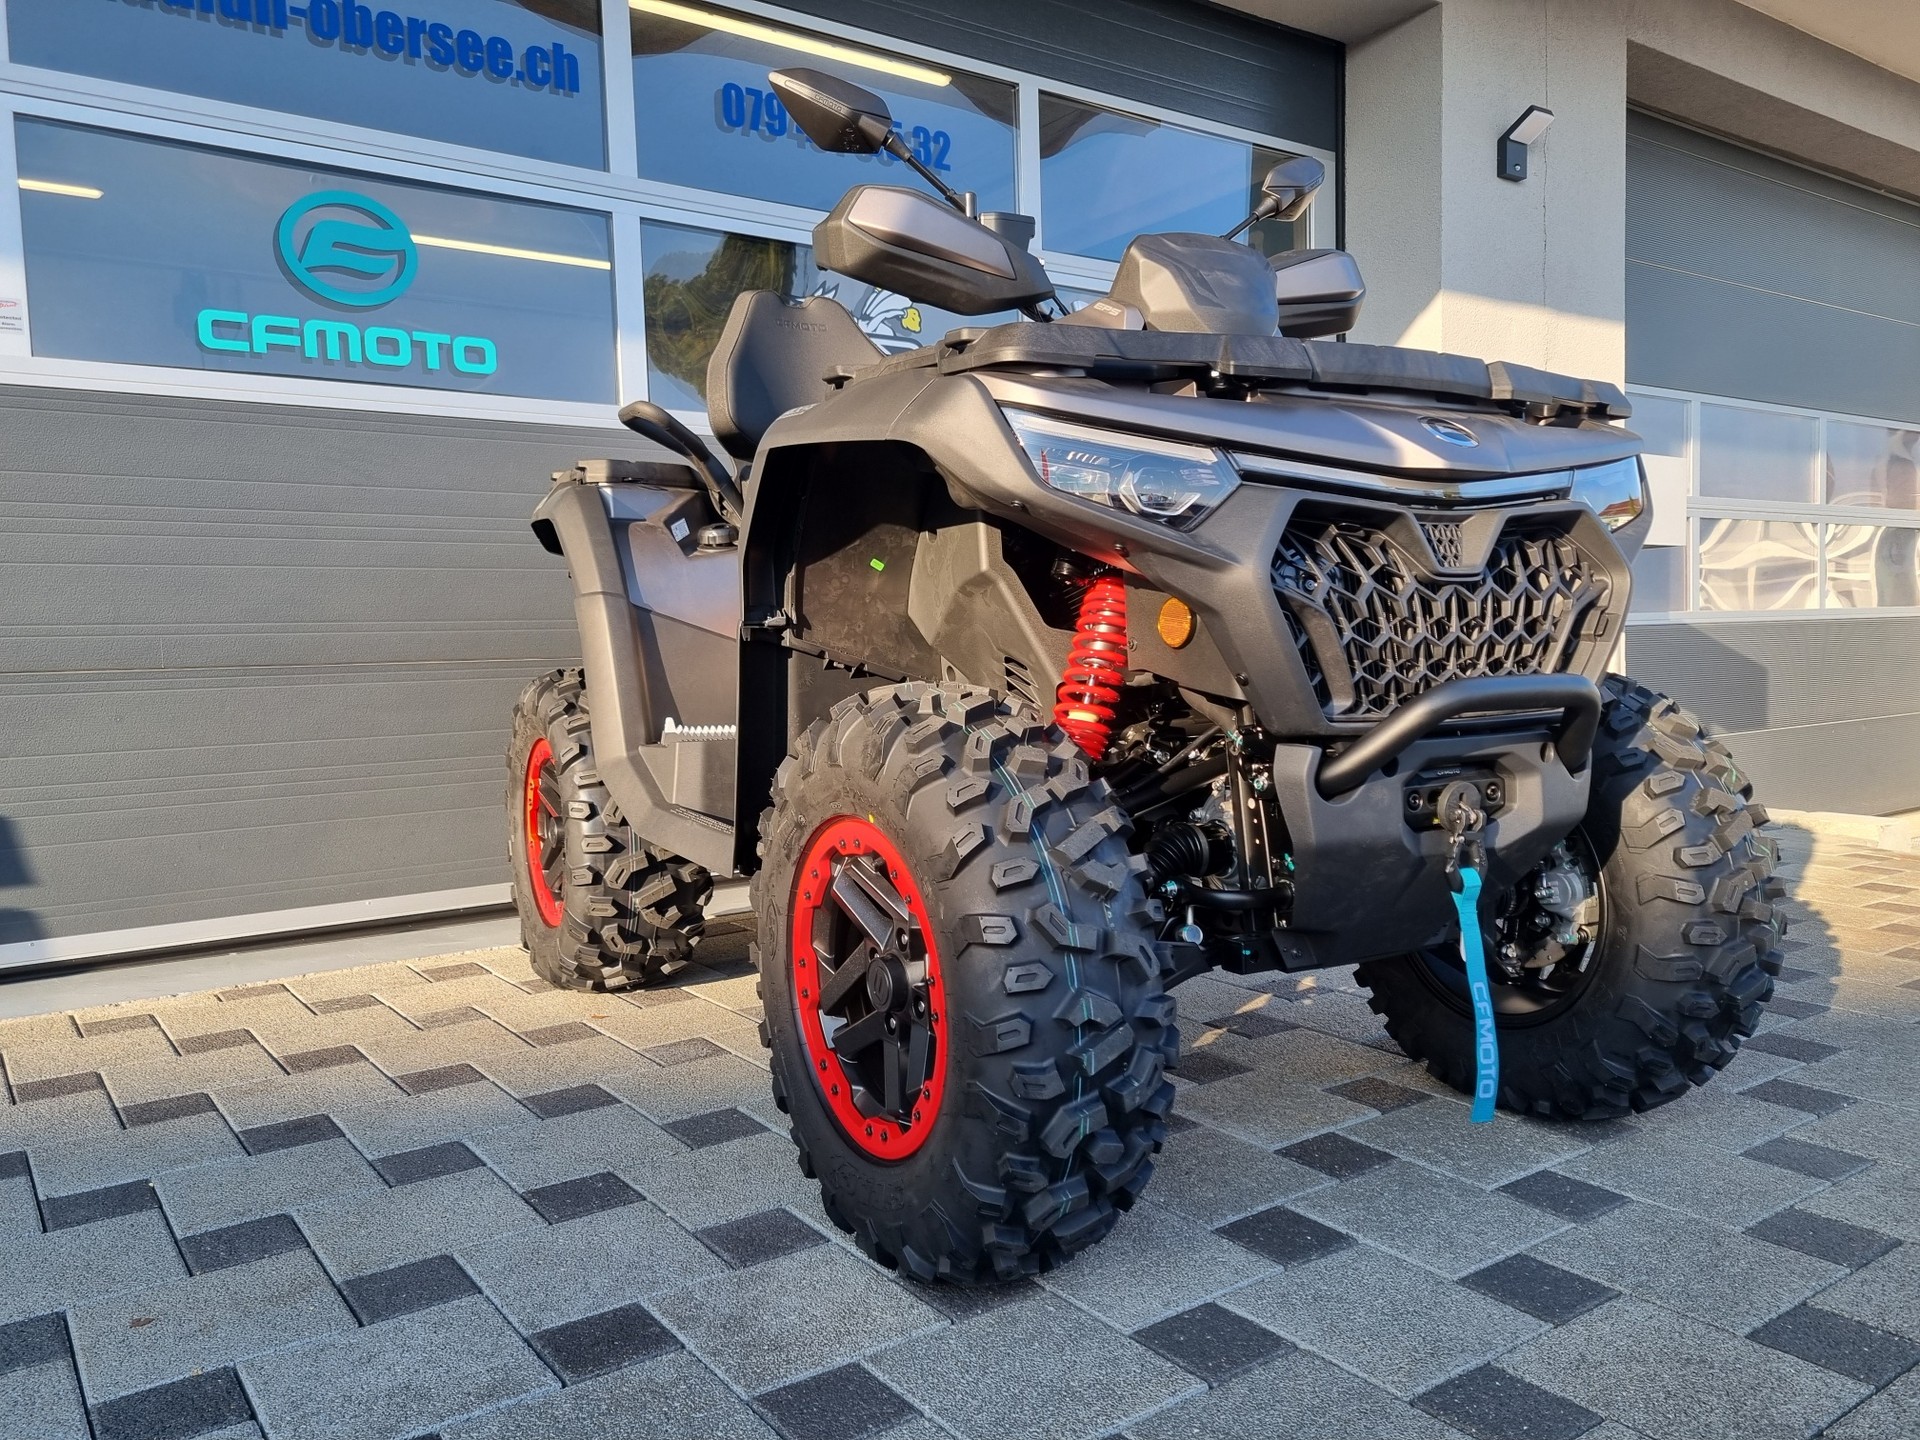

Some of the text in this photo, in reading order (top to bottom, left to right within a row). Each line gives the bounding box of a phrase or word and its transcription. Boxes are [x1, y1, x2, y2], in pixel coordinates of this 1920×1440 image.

[165, 0, 581, 93] n-obersee.ch
[722, 82, 787, 137] 079
[911, 125, 951, 171] 32
[197, 308, 498, 375] CFMOTO
[1093, 302, 1122, 316] EPS
[1473, 981, 1496, 1099] CFMOTO
